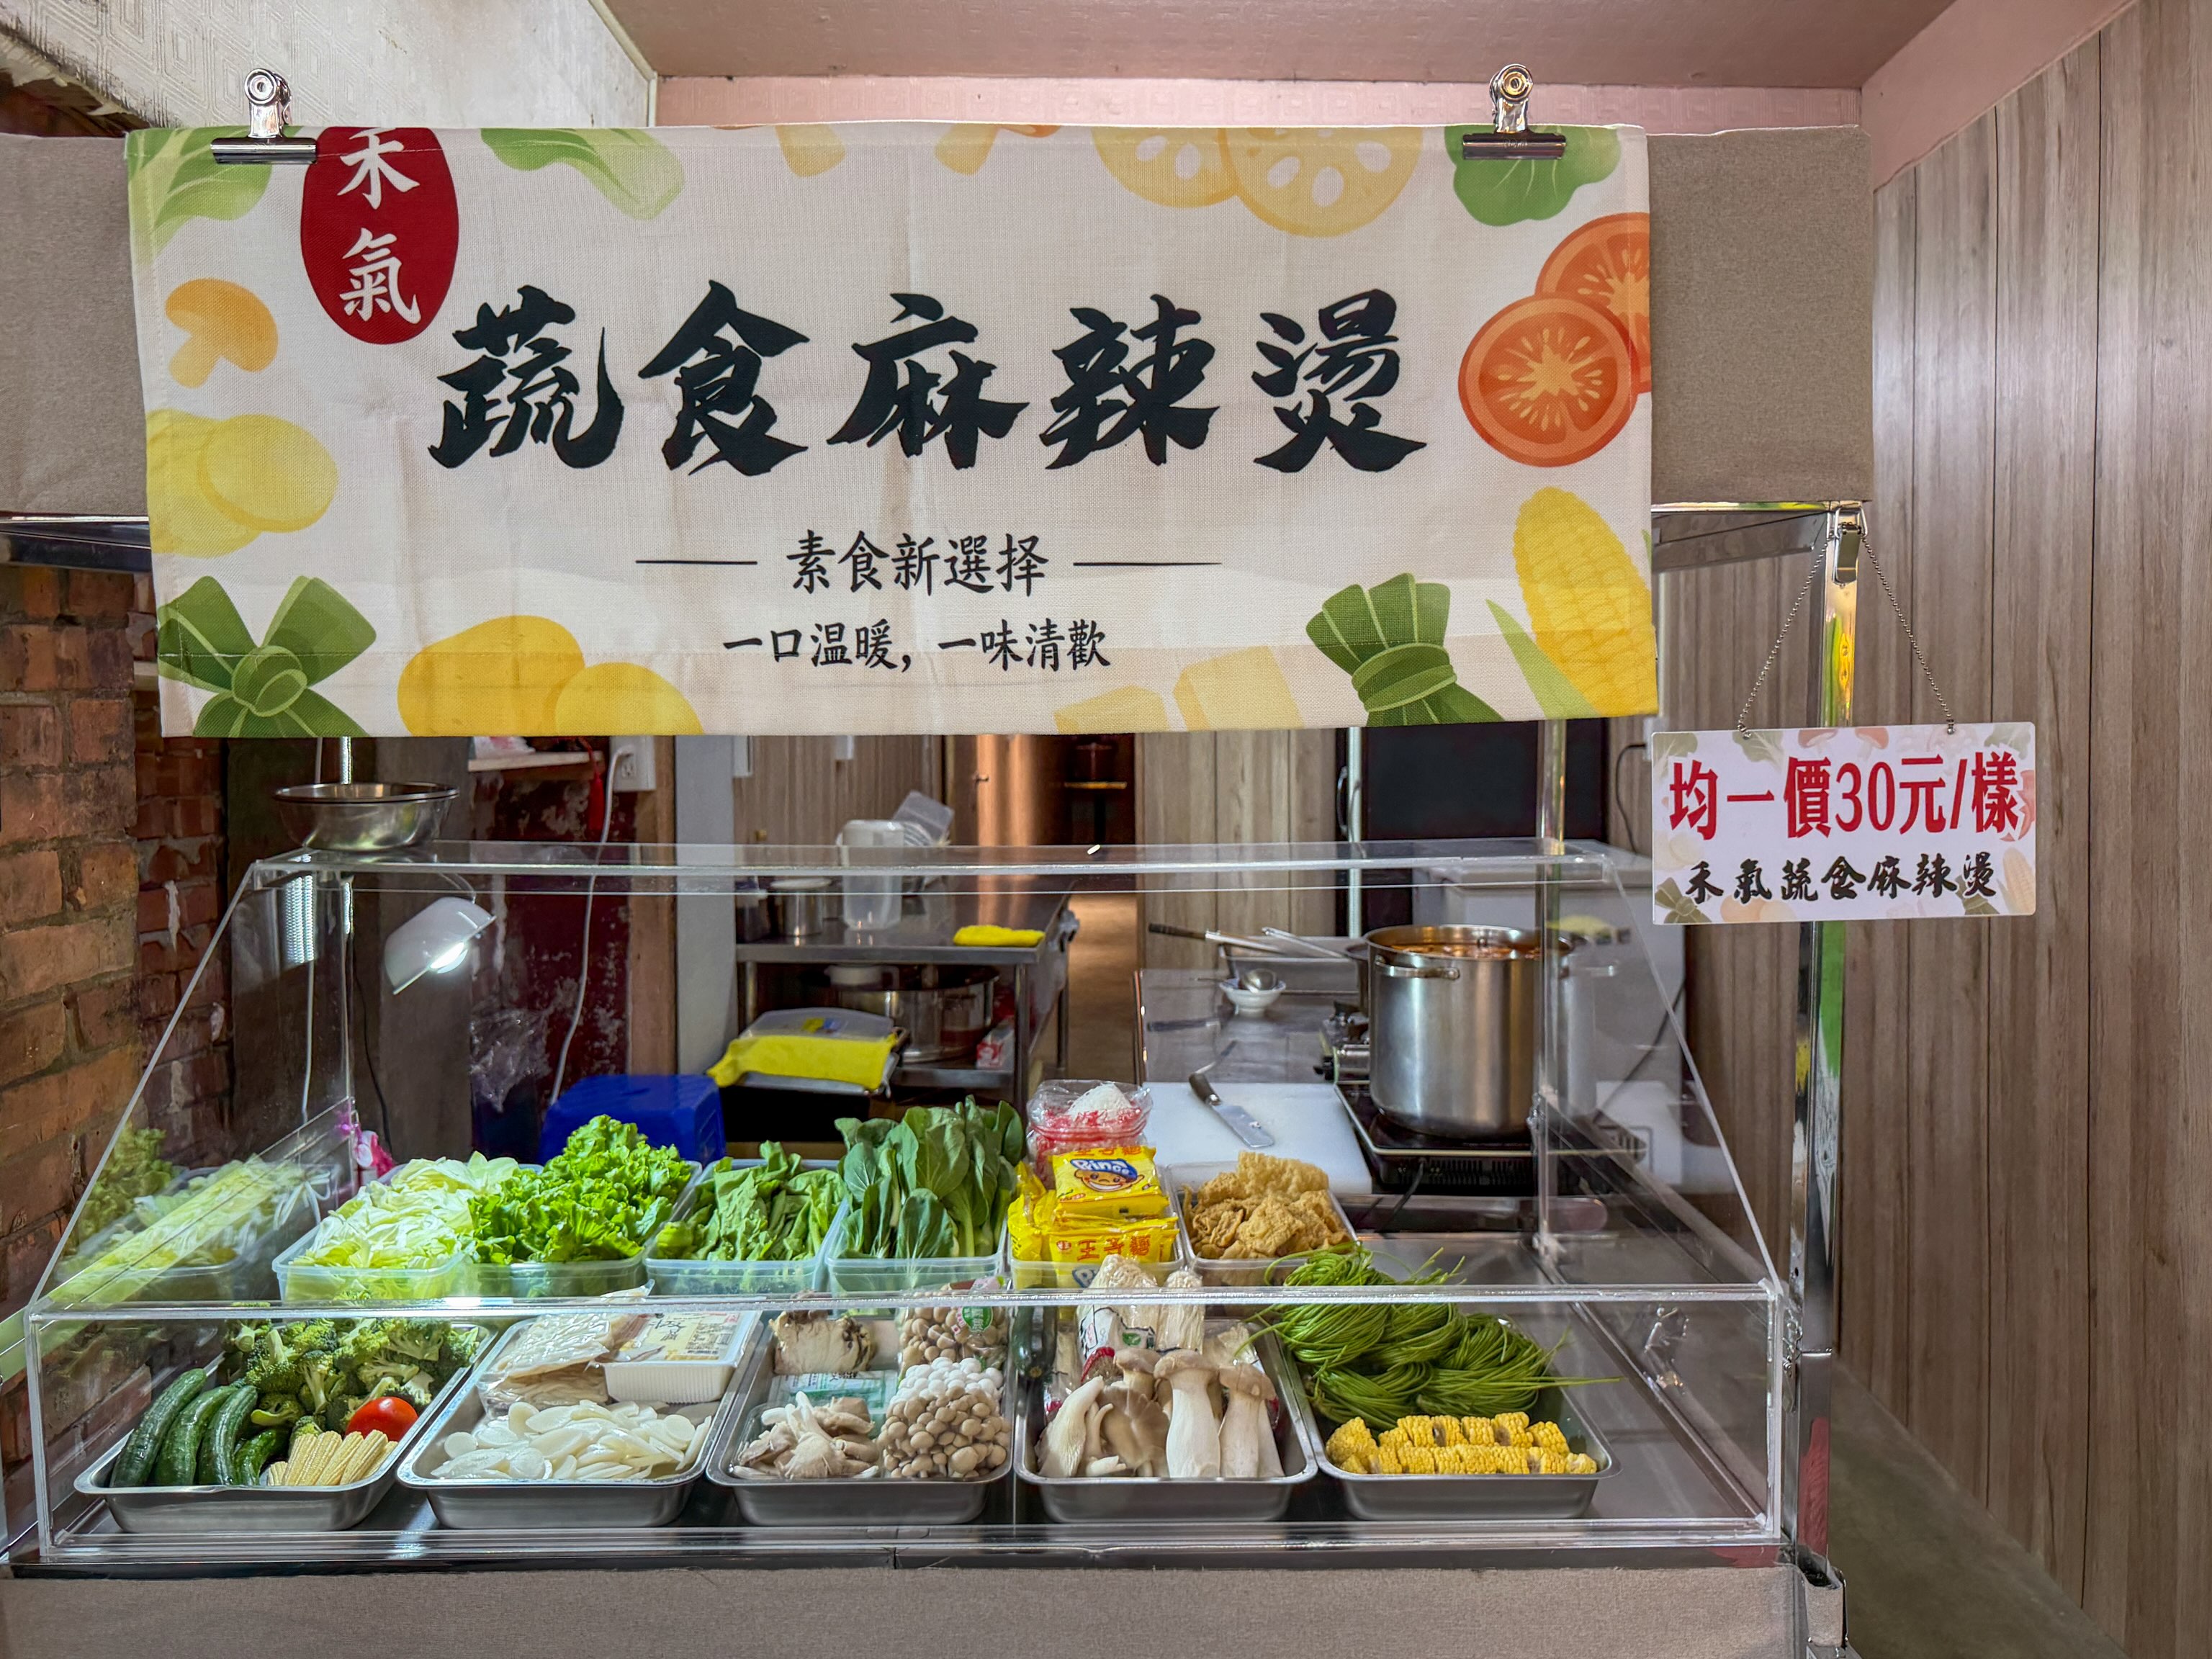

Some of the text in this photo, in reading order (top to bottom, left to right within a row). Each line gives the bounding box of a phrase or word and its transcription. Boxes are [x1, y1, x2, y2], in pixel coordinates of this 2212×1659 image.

[336, 128, 421, 324] 禾氣
[428, 279, 1427, 476] 蔬食麻辣燙
[1668, 751, 2019, 841] 均一價30元/樣
[1685, 851, 1997, 905] 禾氣蔬食麻辣燙
